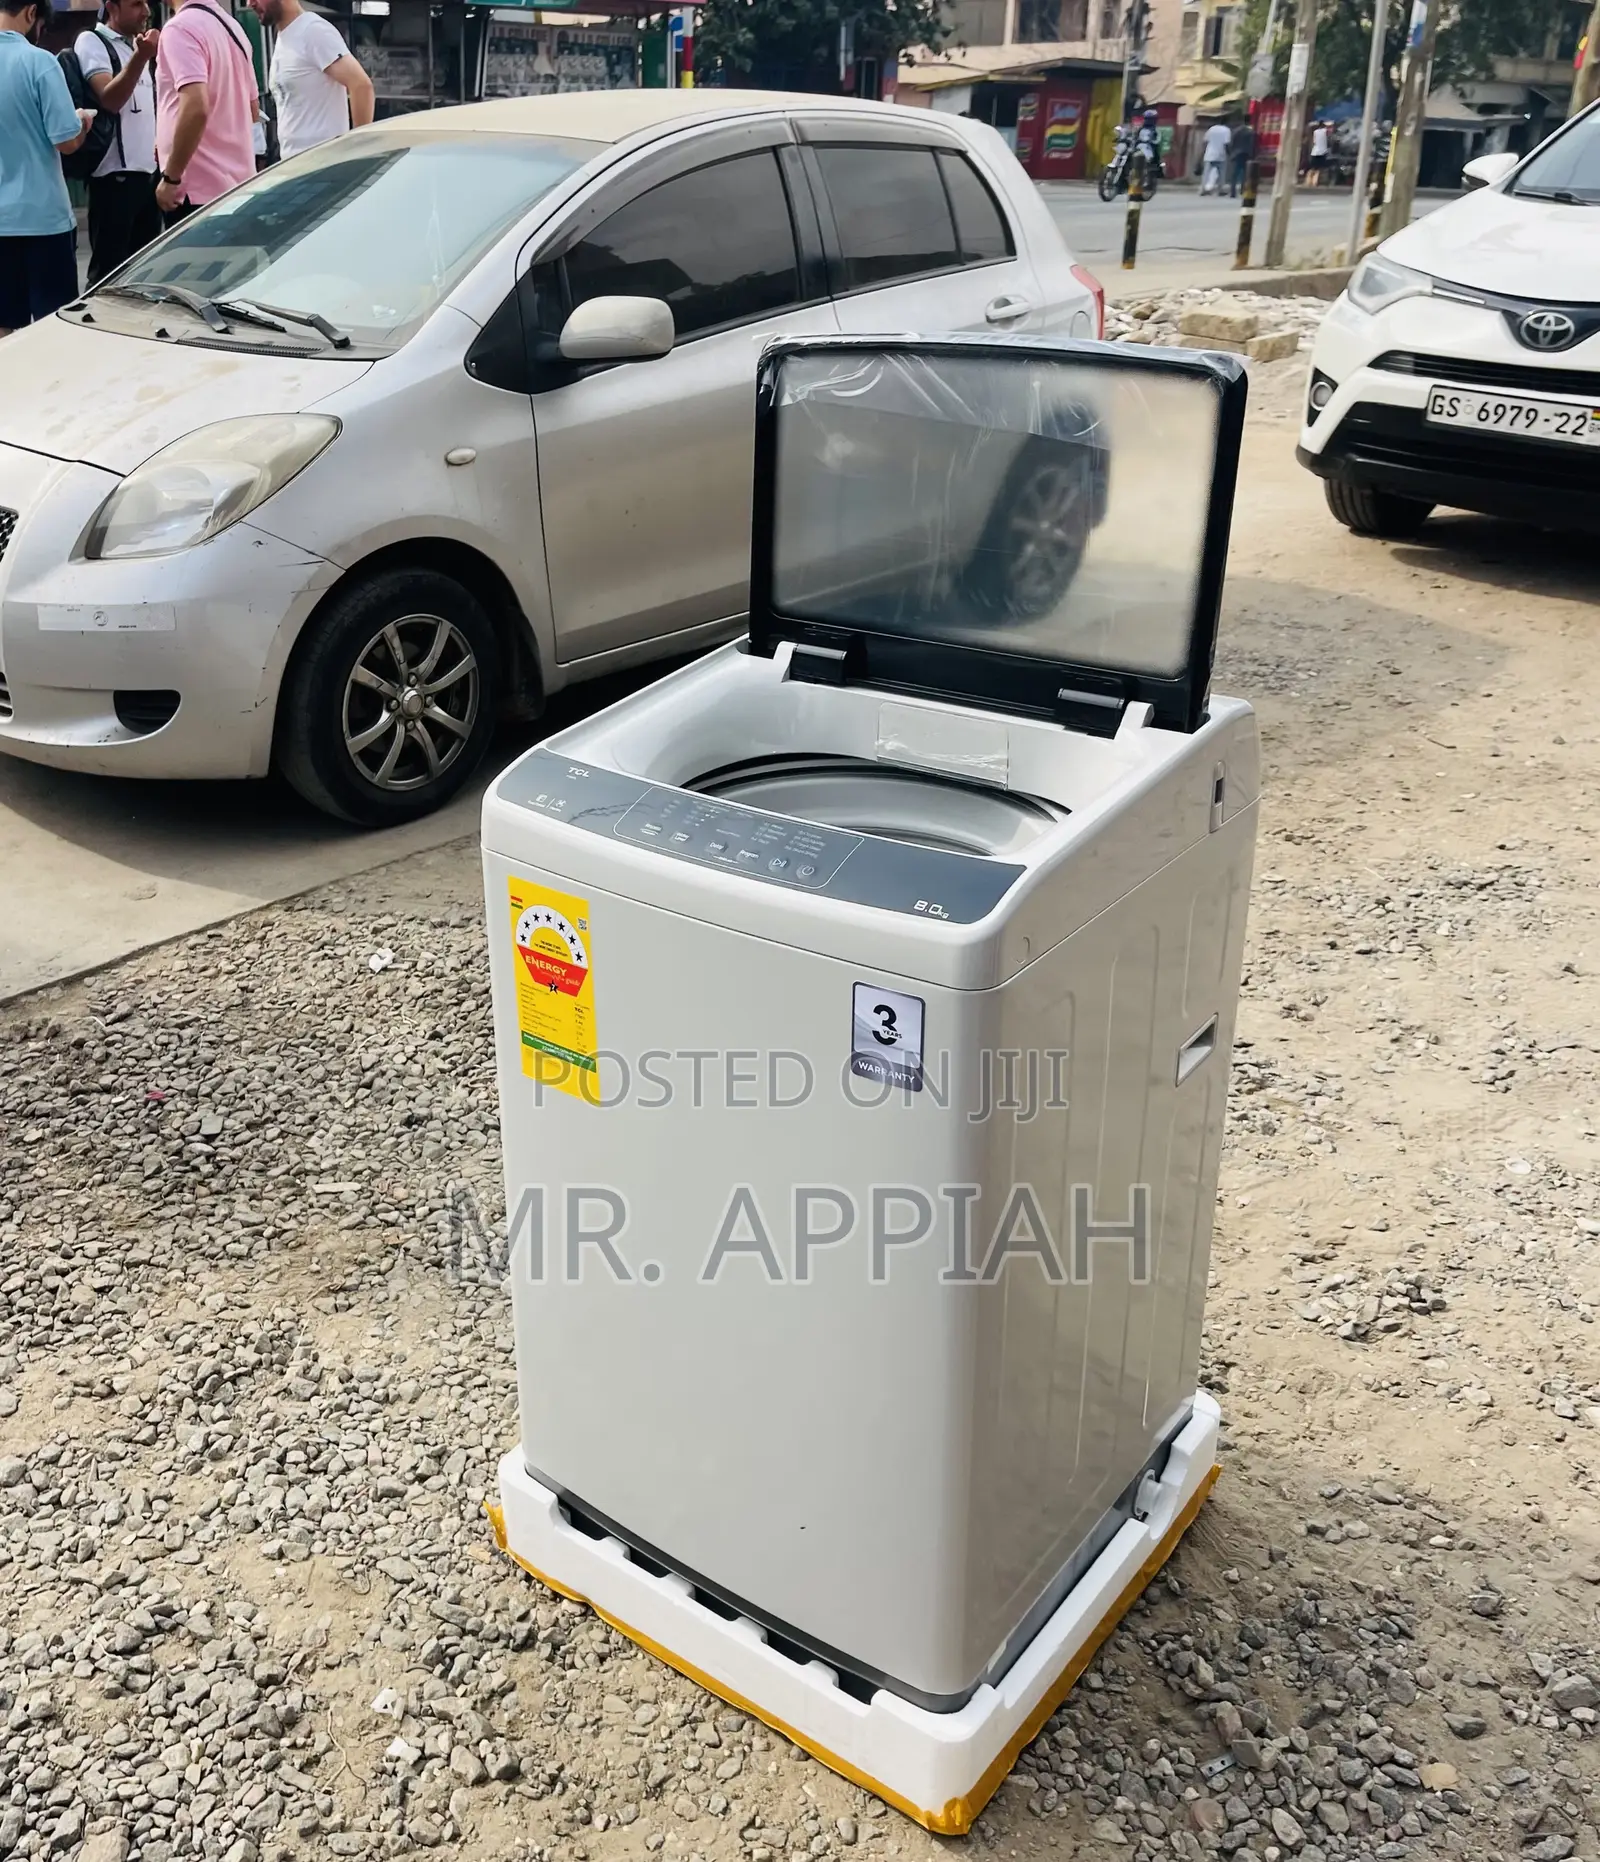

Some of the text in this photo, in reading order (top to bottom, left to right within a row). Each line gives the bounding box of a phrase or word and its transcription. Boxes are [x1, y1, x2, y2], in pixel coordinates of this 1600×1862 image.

[1431, 394, 1588, 437] GS 6979-22
[568, 766, 590, 778] TCL
[525, 955, 567, 977] ENERGY
[872, 1004, 898, 1046] 3
[882, 1028, 903, 1040] YEARS
[858, 1060, 915, 1084] WARRANTY
